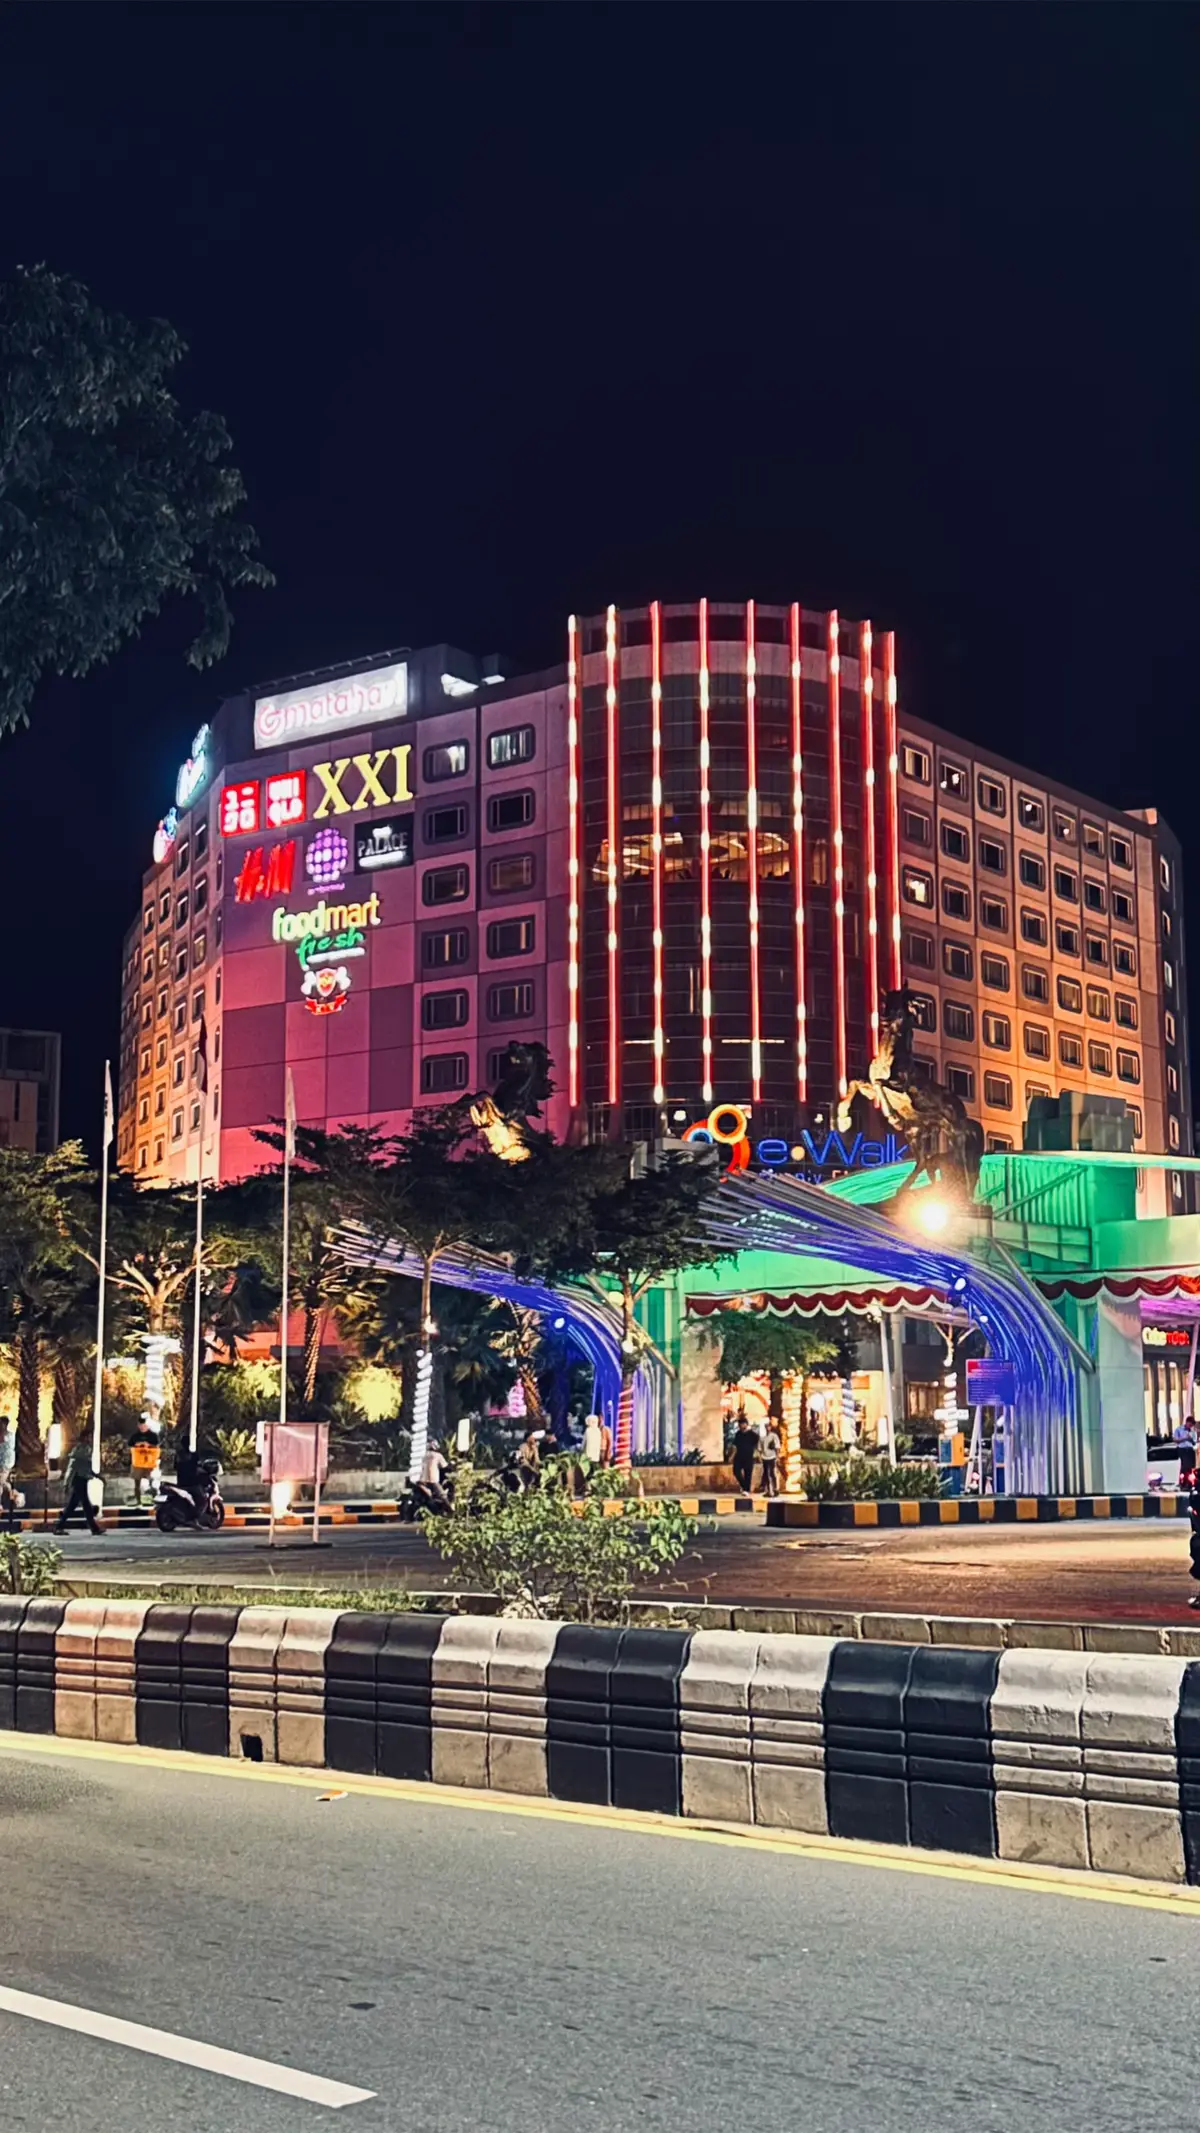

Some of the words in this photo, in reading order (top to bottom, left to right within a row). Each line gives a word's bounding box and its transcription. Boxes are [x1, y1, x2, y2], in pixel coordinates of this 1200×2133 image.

[312, 745, 413, 819] XXI
[234, 840, 296, 903] H&M
[272, 893, 381, 943] foodmart
[295, 926, 365, 971] fresh
